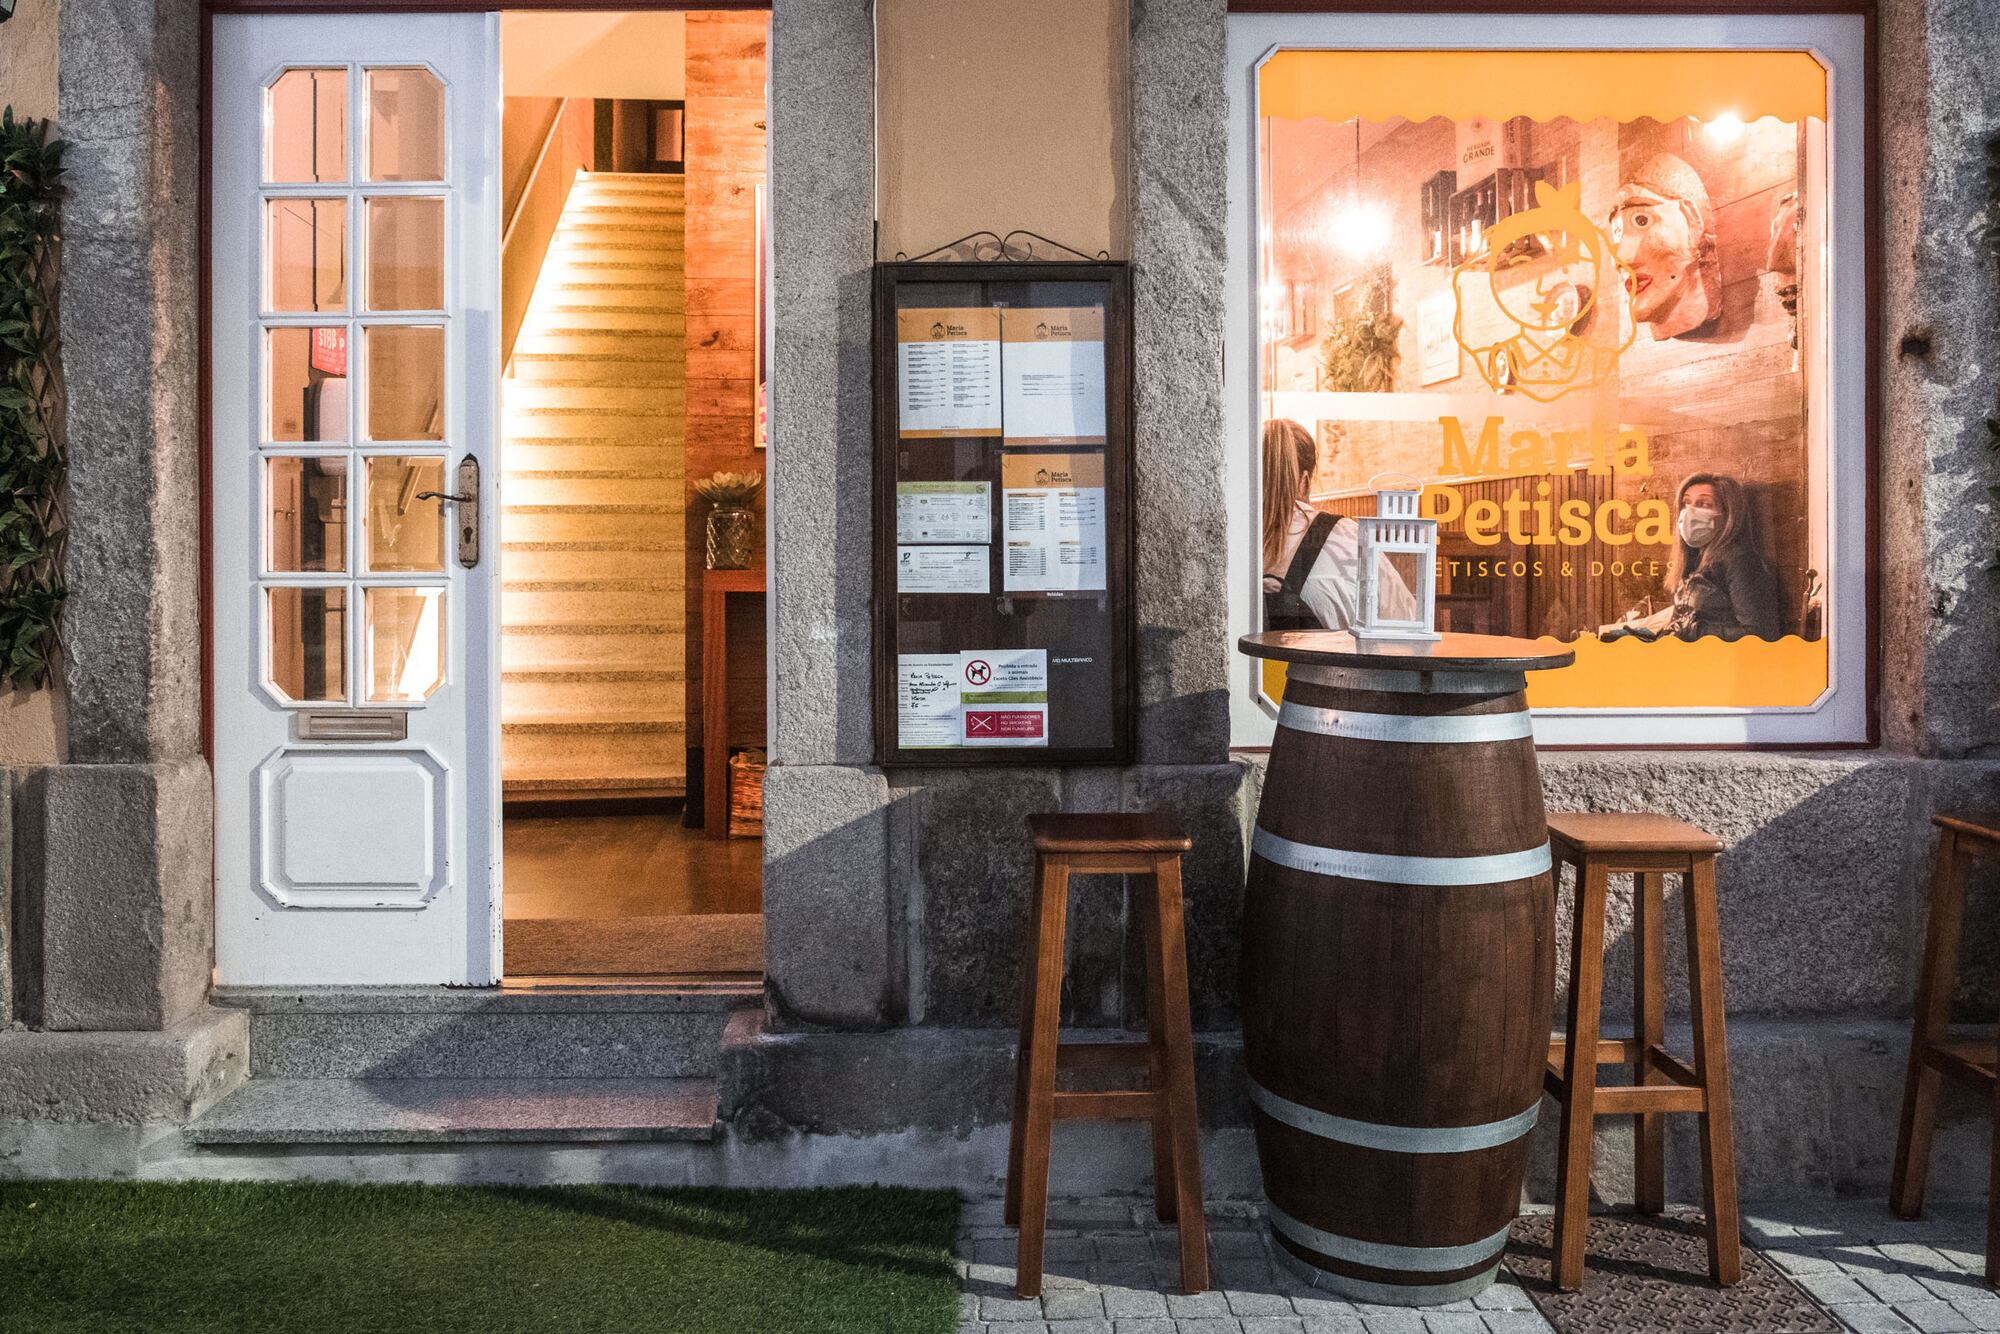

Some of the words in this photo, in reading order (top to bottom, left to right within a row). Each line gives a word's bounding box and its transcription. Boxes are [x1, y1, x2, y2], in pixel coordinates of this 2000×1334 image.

[1463, 146, 1495, 163] GRANDE
[1437, 416, 1653, 476] Maria
[1417, 481, 1676, 546] Petisca
[1435, 560, 1544, 577] ETISCOS
[1561, 560, 1573, 577] &
